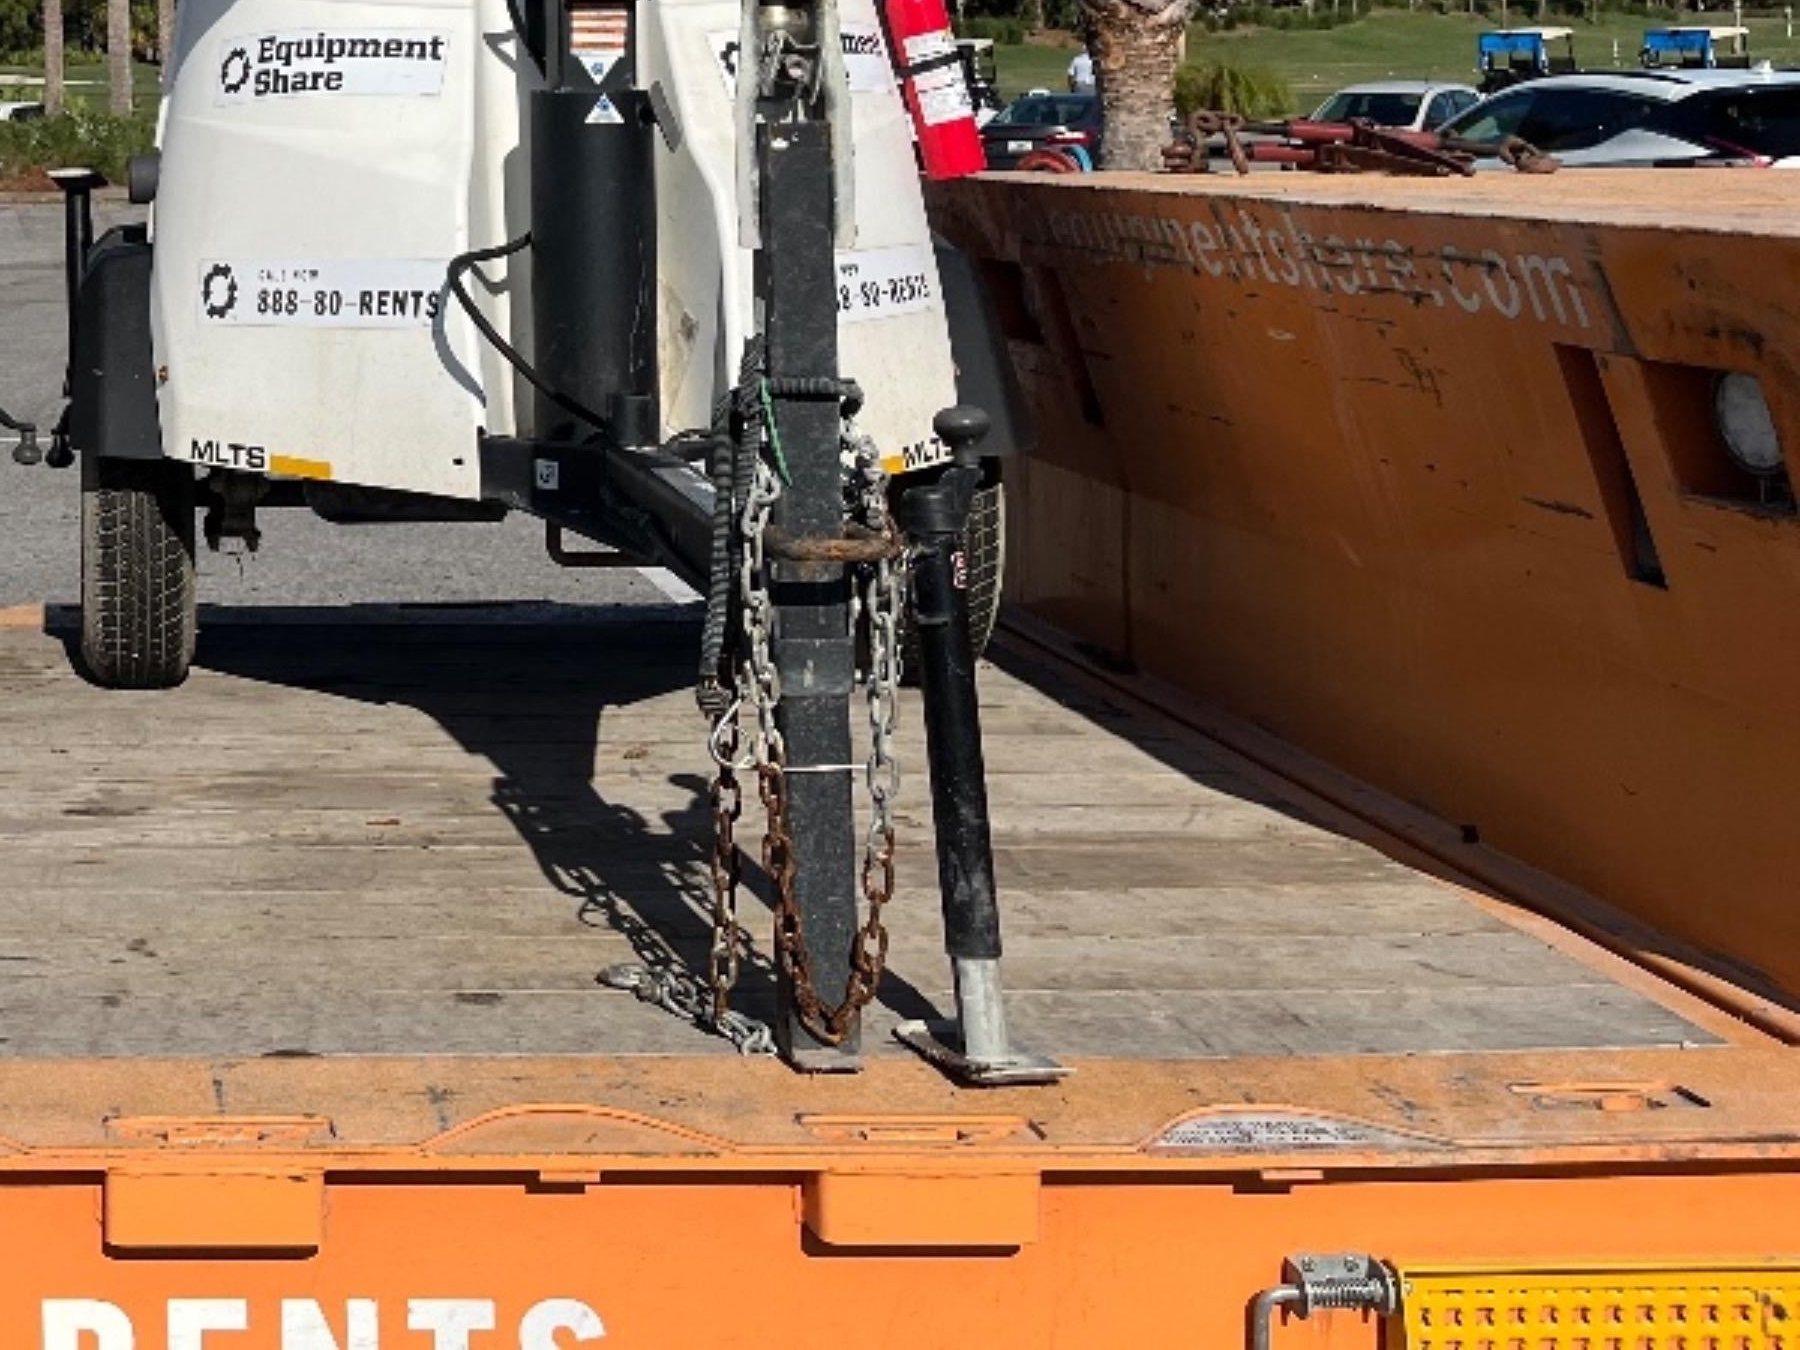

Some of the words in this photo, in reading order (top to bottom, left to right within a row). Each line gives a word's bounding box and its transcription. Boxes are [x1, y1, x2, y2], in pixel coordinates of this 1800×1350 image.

[257, 33, 444, 67] Equipment
[254, 69, 343, 96] Share
[257, 290, 441, 319] 888-80-RENTS
[190, 438, 266, 469] MLTS
